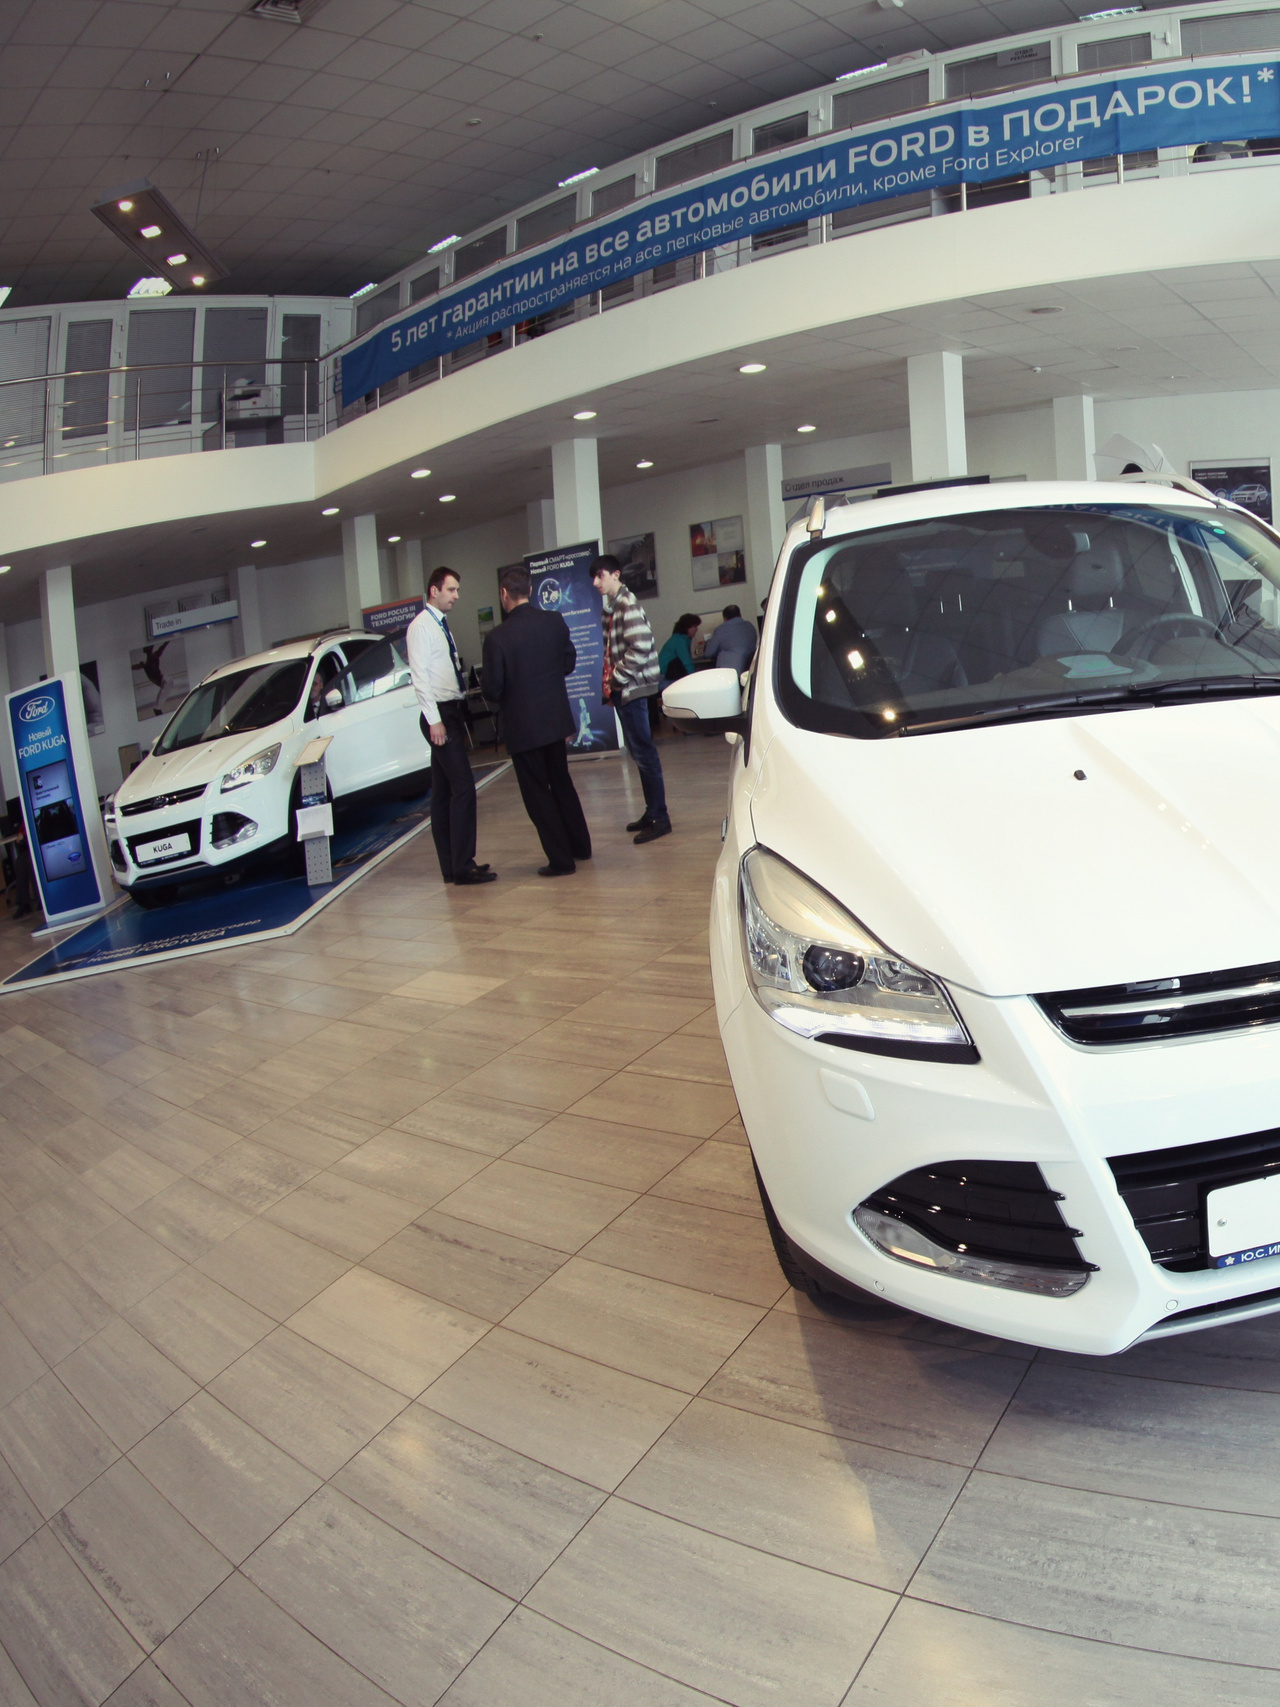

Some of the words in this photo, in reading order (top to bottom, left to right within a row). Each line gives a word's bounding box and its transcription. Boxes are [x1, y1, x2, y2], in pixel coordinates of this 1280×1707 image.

[391, 330, 402, 352] 5
[405, 315, 438, 346] лет
[442, 266, 543, 328] гарантии
[551, 251, 578, 280] на
[585, 230, 629, 265] все
[636, 158, 836, 242] автомобили
[849, 125, 954, 174] FORD
[968, 125, 990, 147] в
[454, 314, 490, 340] Акция
[491, 263, 610, 325] распространяется
[613, 256, 632, 273] на
[635, 245, 662, 264] все
[666, 215, 744, 255] легковые
[748, 182, 869, 226] автомобили,
[873, 163, 936, 194] кроме
[942, 151, 990, 175] Ford
[995, 134, 1083, 167] Explorer
[784, 482, 811, 492] Отдел
[811, 476, 844, 488] продаж
[559, 561, 574, 569] KUGA
[370, 612, 388, 621] FORD
[387, 606, 409, 617] FOCUS
[371, 611, 416, 628] ТЕХНОЛОГИИ
[154, 618, 173, 631] Trade
[173, 616, 182, 626] in
[25, 700, 49, 720] Ford
[28, 726, 52, 742] Новый
[18, 742, 42, 760] FORD
[41, 733, 67, 751] KUGA
[152, 842, 173, 854] KUGA
